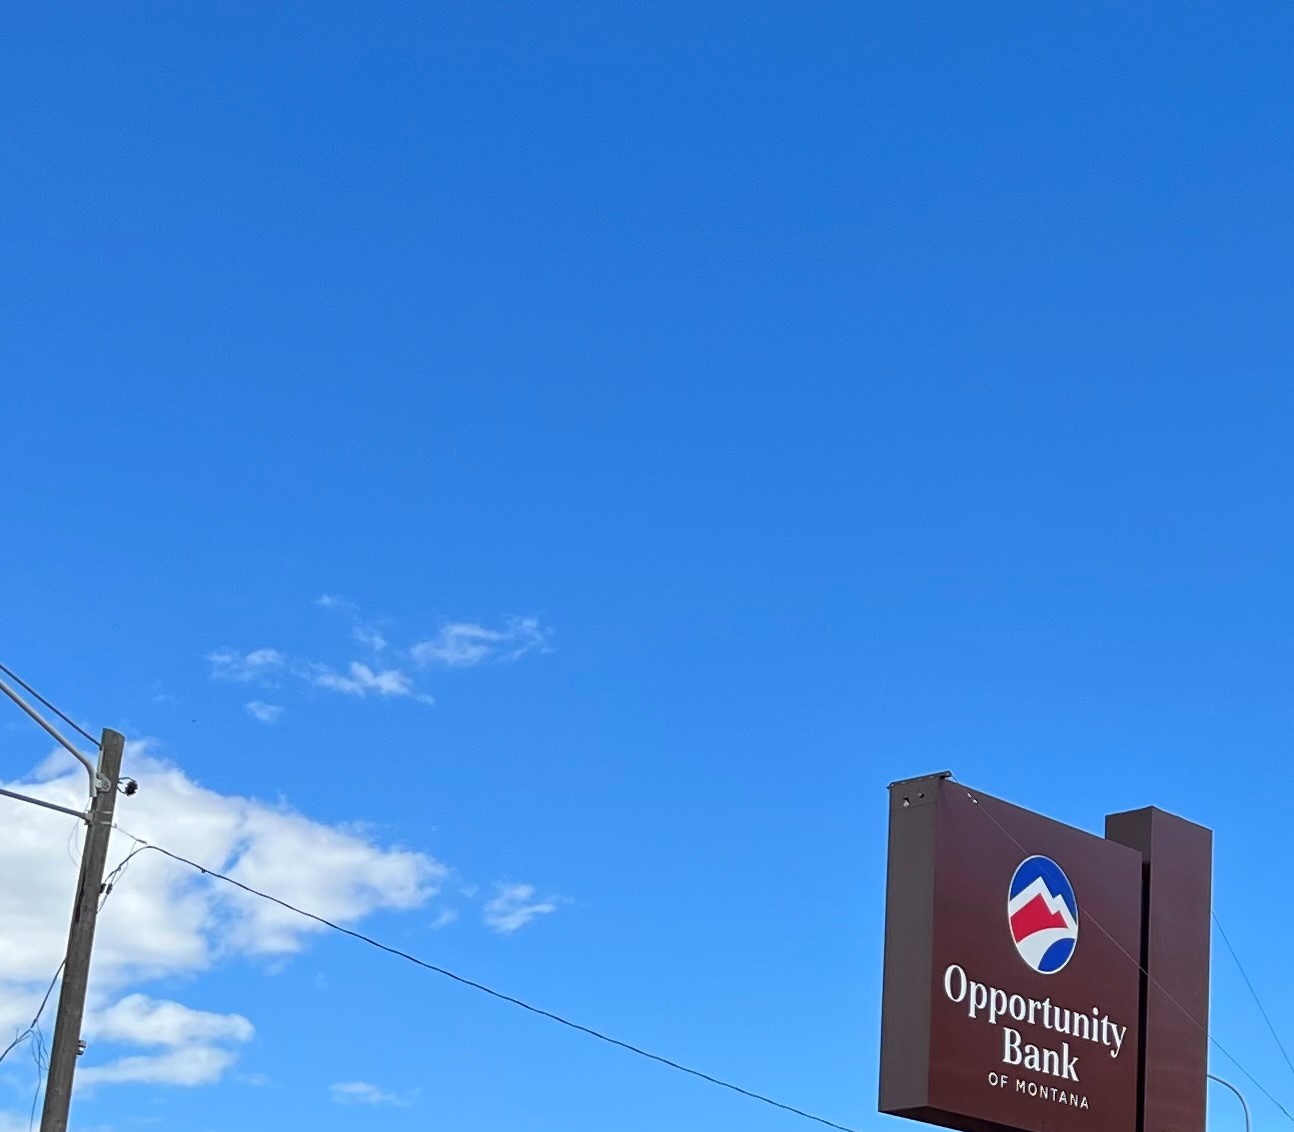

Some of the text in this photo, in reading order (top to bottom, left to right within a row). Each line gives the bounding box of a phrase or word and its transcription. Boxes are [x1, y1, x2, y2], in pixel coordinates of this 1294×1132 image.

[944, 964, 1127, 1059] Opportunity
[1002, 1026, 1080, 1082] Bank
[988, 1071, 1090, 1110] OF MONTANA
